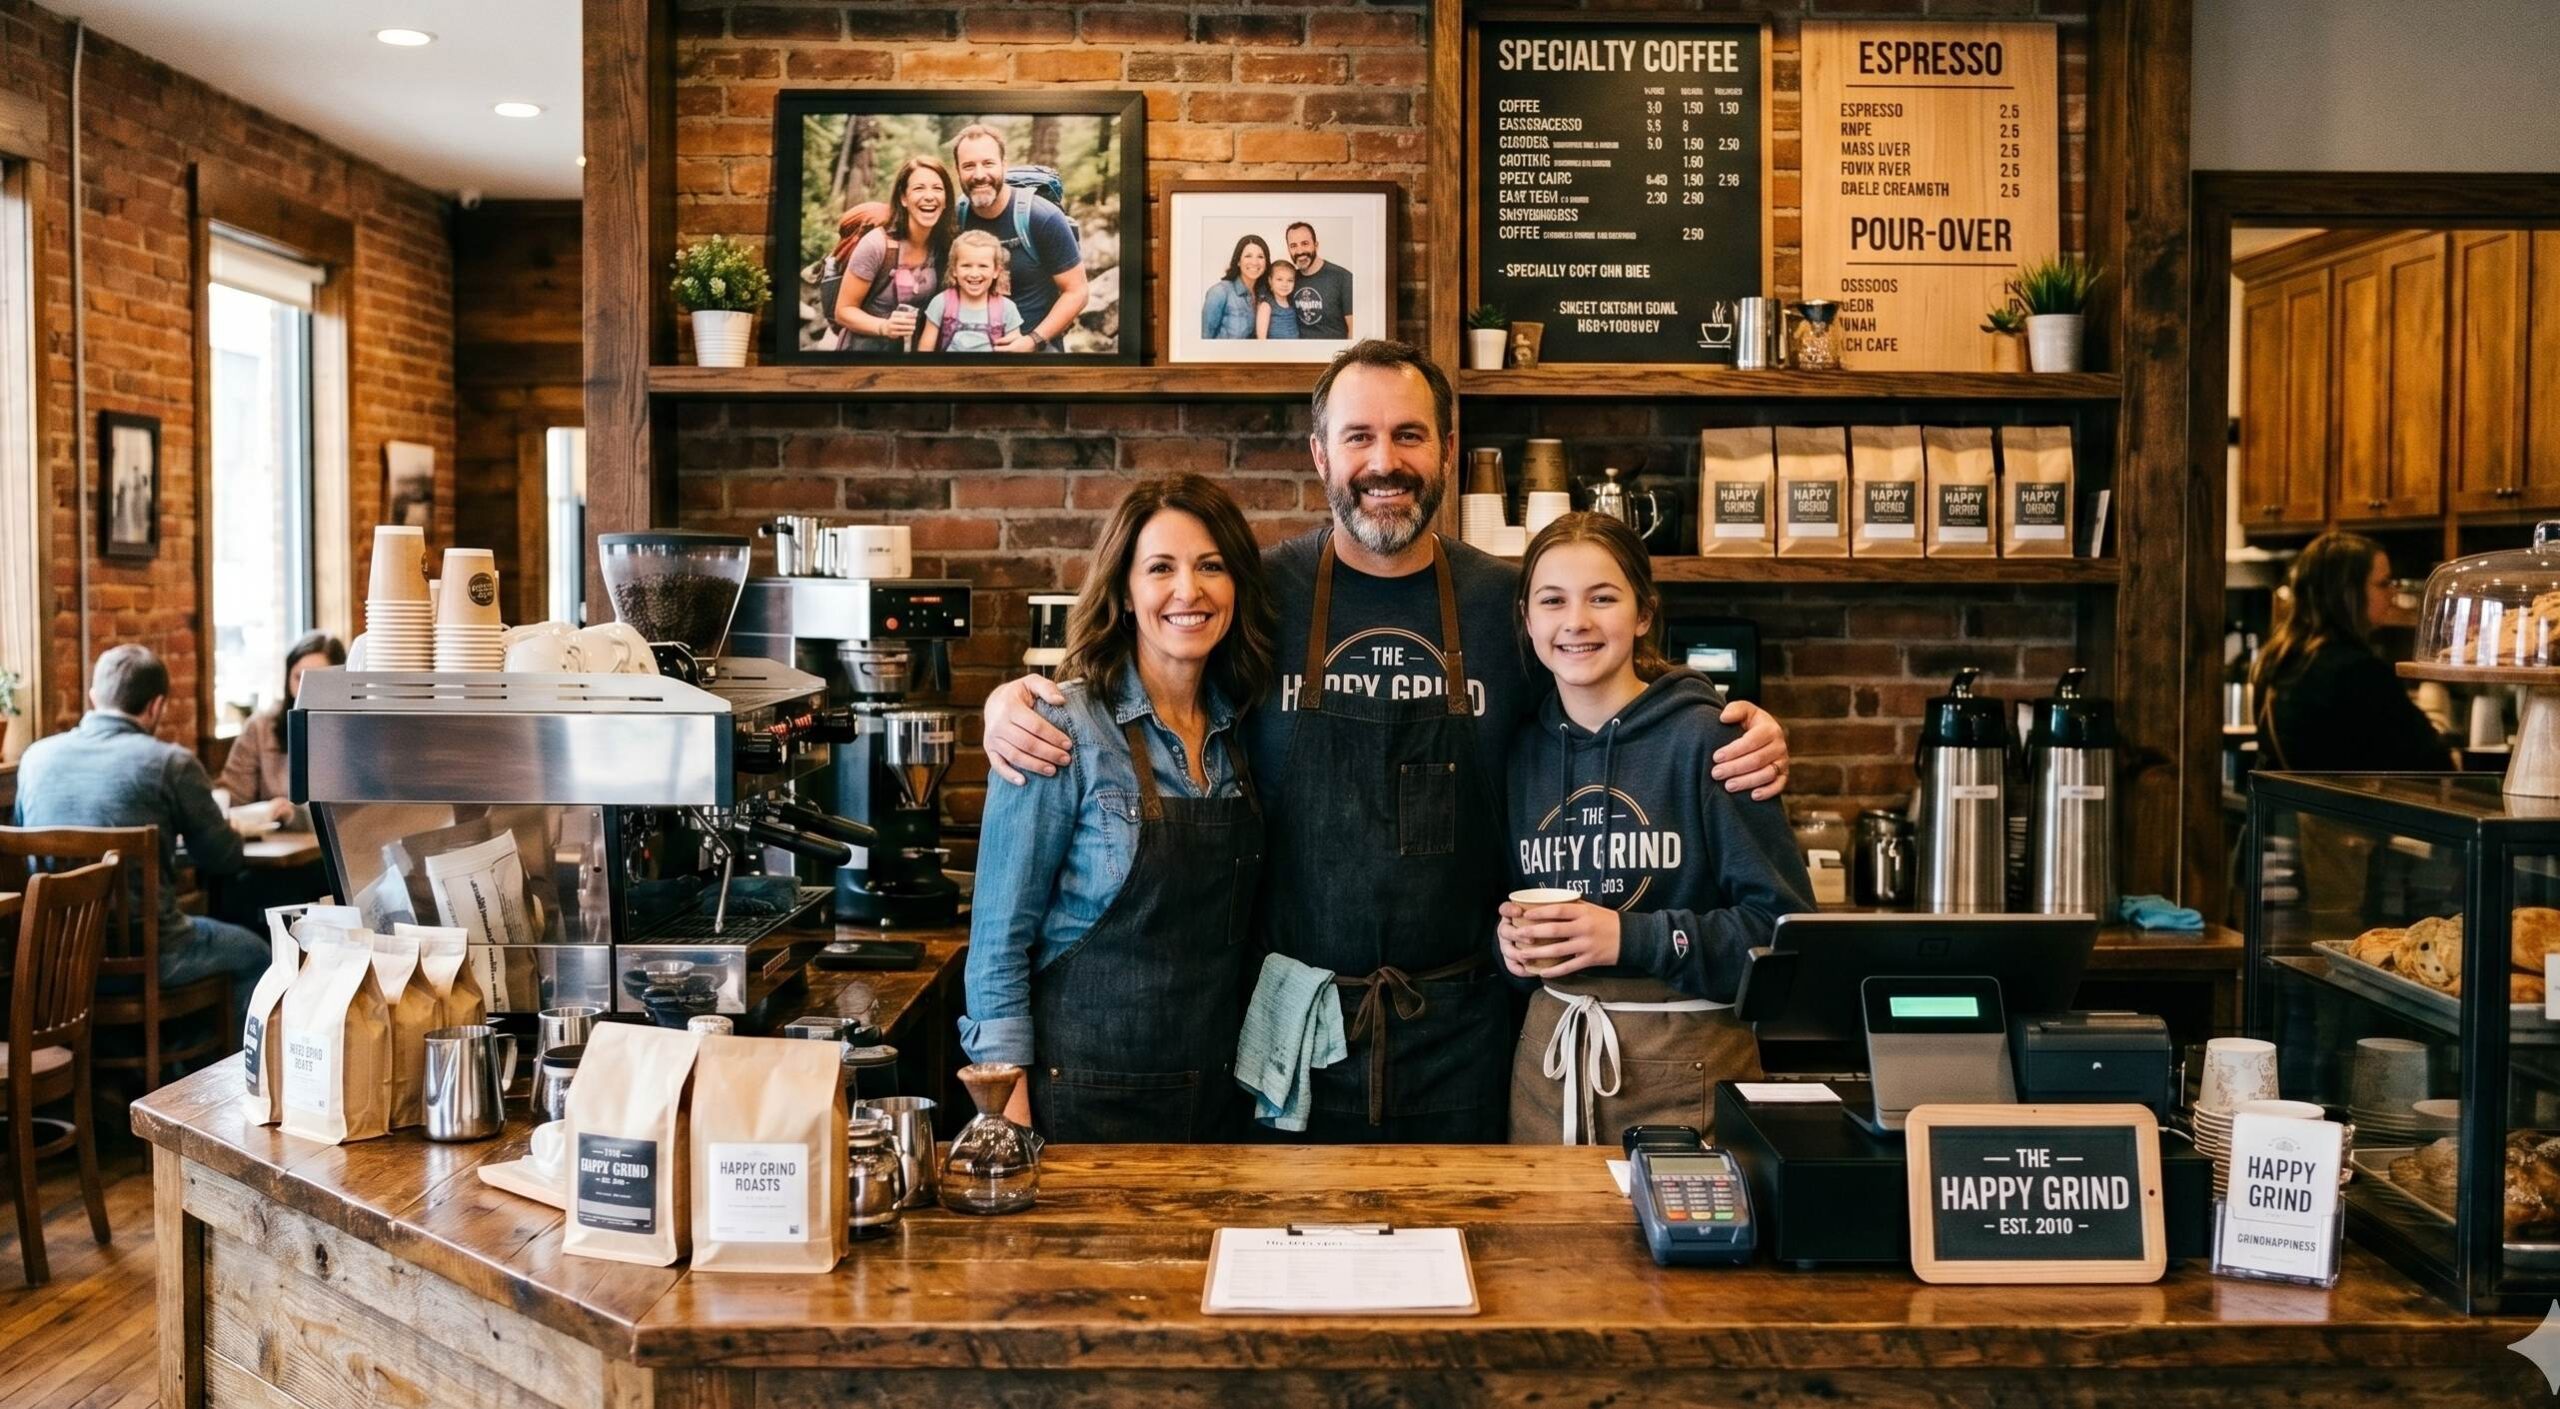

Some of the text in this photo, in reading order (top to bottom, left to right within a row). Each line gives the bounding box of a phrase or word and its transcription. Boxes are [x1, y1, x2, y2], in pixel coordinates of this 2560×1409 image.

[1499, 40, 1739, 73] SPECIALTY COFFEE
[1859, 41, 2003, 76] ESPRESSO
[1499, 99, 1541, 113] COFFEE
[1840, 103, 2020, 119] ESPRESSO 2.5
[1499, 226, 1541, 240] COFFEE
[1851, 216, 2012, 252] POUR-OVER
[1506, 263, 1567, 278] SPECIALLY
[1841, 338, 1899, 352] CH CAFE
[1720, 489, 1759, 501] HAPPY
[1794, 489, 1832, 500] HAPPY
[1870, 489, 1909, 501] HAPPY
[1944, 493, 1983, 504] HAPPY
[2021, 490, 2060, 502] HAPPY
[1371, 646, 1405, 667] THE
[1582, 807, 1605, 826] THE
[2016, 1148, 2051, 1168] THE
[720, 1161, 796, 1176] HAPPY GRIND
[2248, 1155, 2317, 1185] HAPPY
[735, 1178, 780, 1192] ROASTS
[1941, 1176, 2130, 1211] HAPPY GRIND
[2249, 1184, 2312, 1213] GRIND
[2000, 1217, 2074, 1235] EST. 2010
